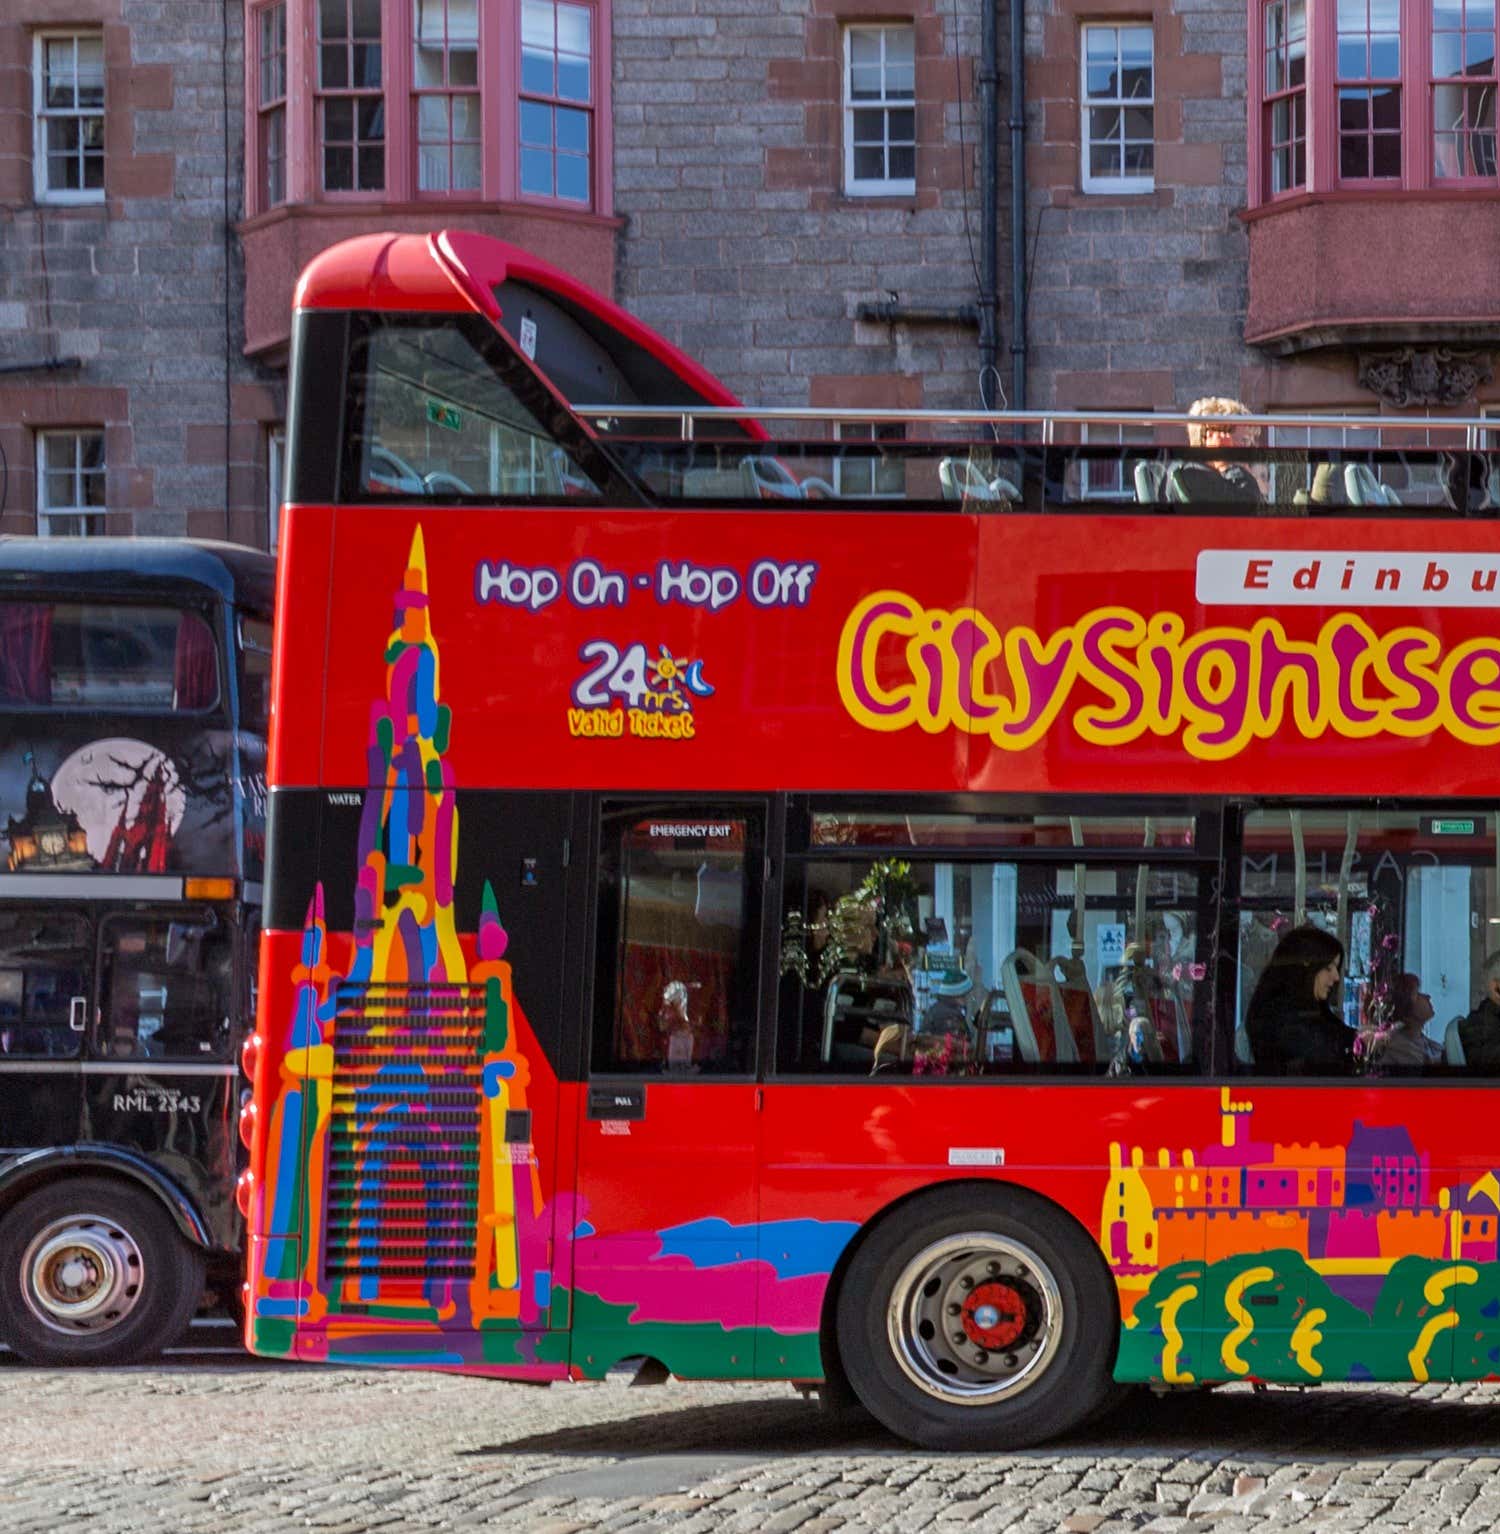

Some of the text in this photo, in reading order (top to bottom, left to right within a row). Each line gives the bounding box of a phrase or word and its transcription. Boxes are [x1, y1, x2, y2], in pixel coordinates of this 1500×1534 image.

[478, 561, 561, 610] Hop
[570, 560, 626, 606] On
[658, 561, 741, 610] Hop
[750, 560, 818, 606] Off
[575, 640, 651, 707] 24
[567, 708, 696, 739] Valid Ticket
[327, 792, 362, 806] WATER
[649, 824, 731, 838] EMERGENCY EXIT
[113, 1094, 201, 1113] RML 2343
